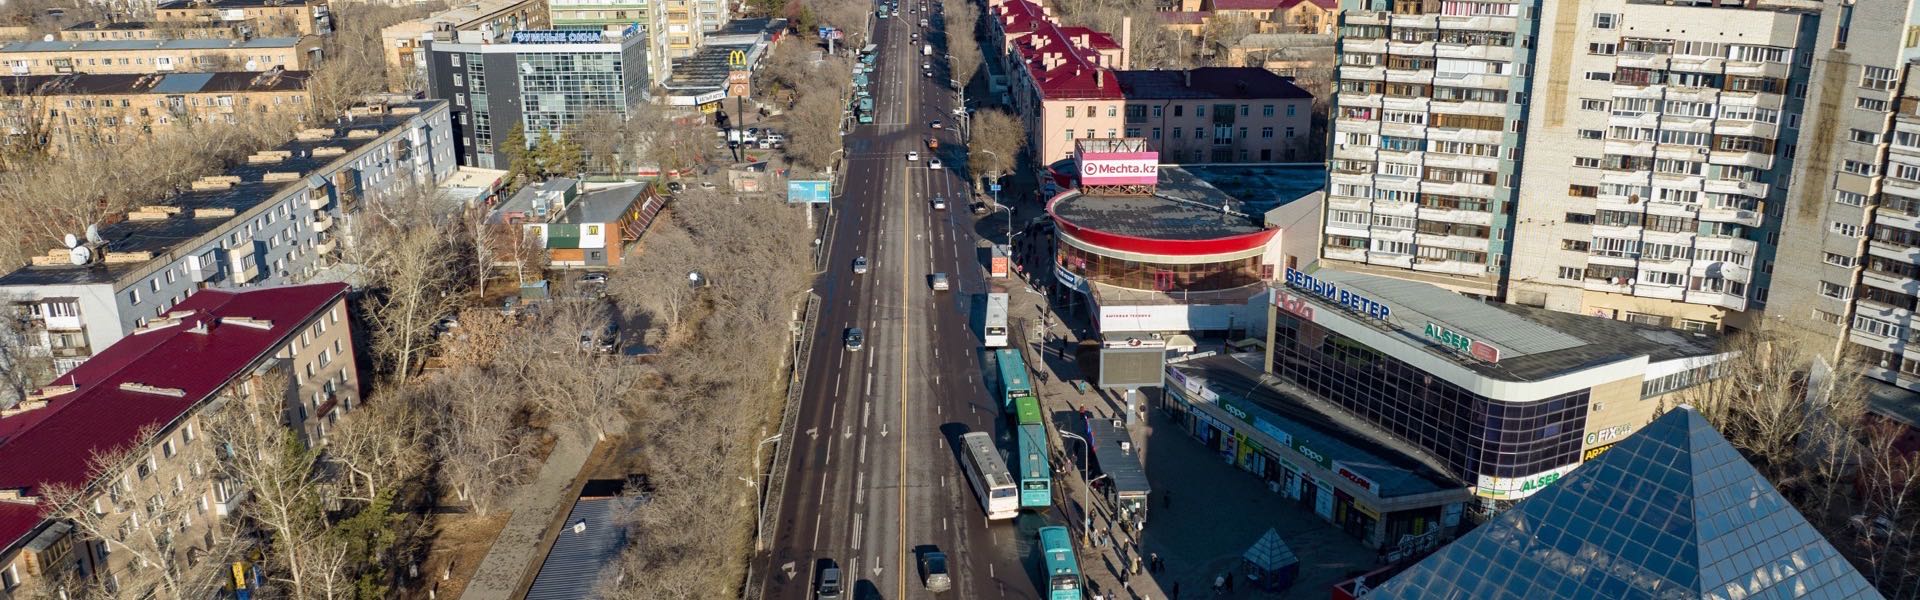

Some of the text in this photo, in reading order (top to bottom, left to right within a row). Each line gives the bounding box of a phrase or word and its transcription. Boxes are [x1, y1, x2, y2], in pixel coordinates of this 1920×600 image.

[1099, 163, 1155, 174] Mechta.kz
[1286, 267, 1391, 320] БЕЛЫЙ ВЕТЕР
[1424, 323, 1471, 352] ALSER
[1520, 472, 1560, 492] ALSER
